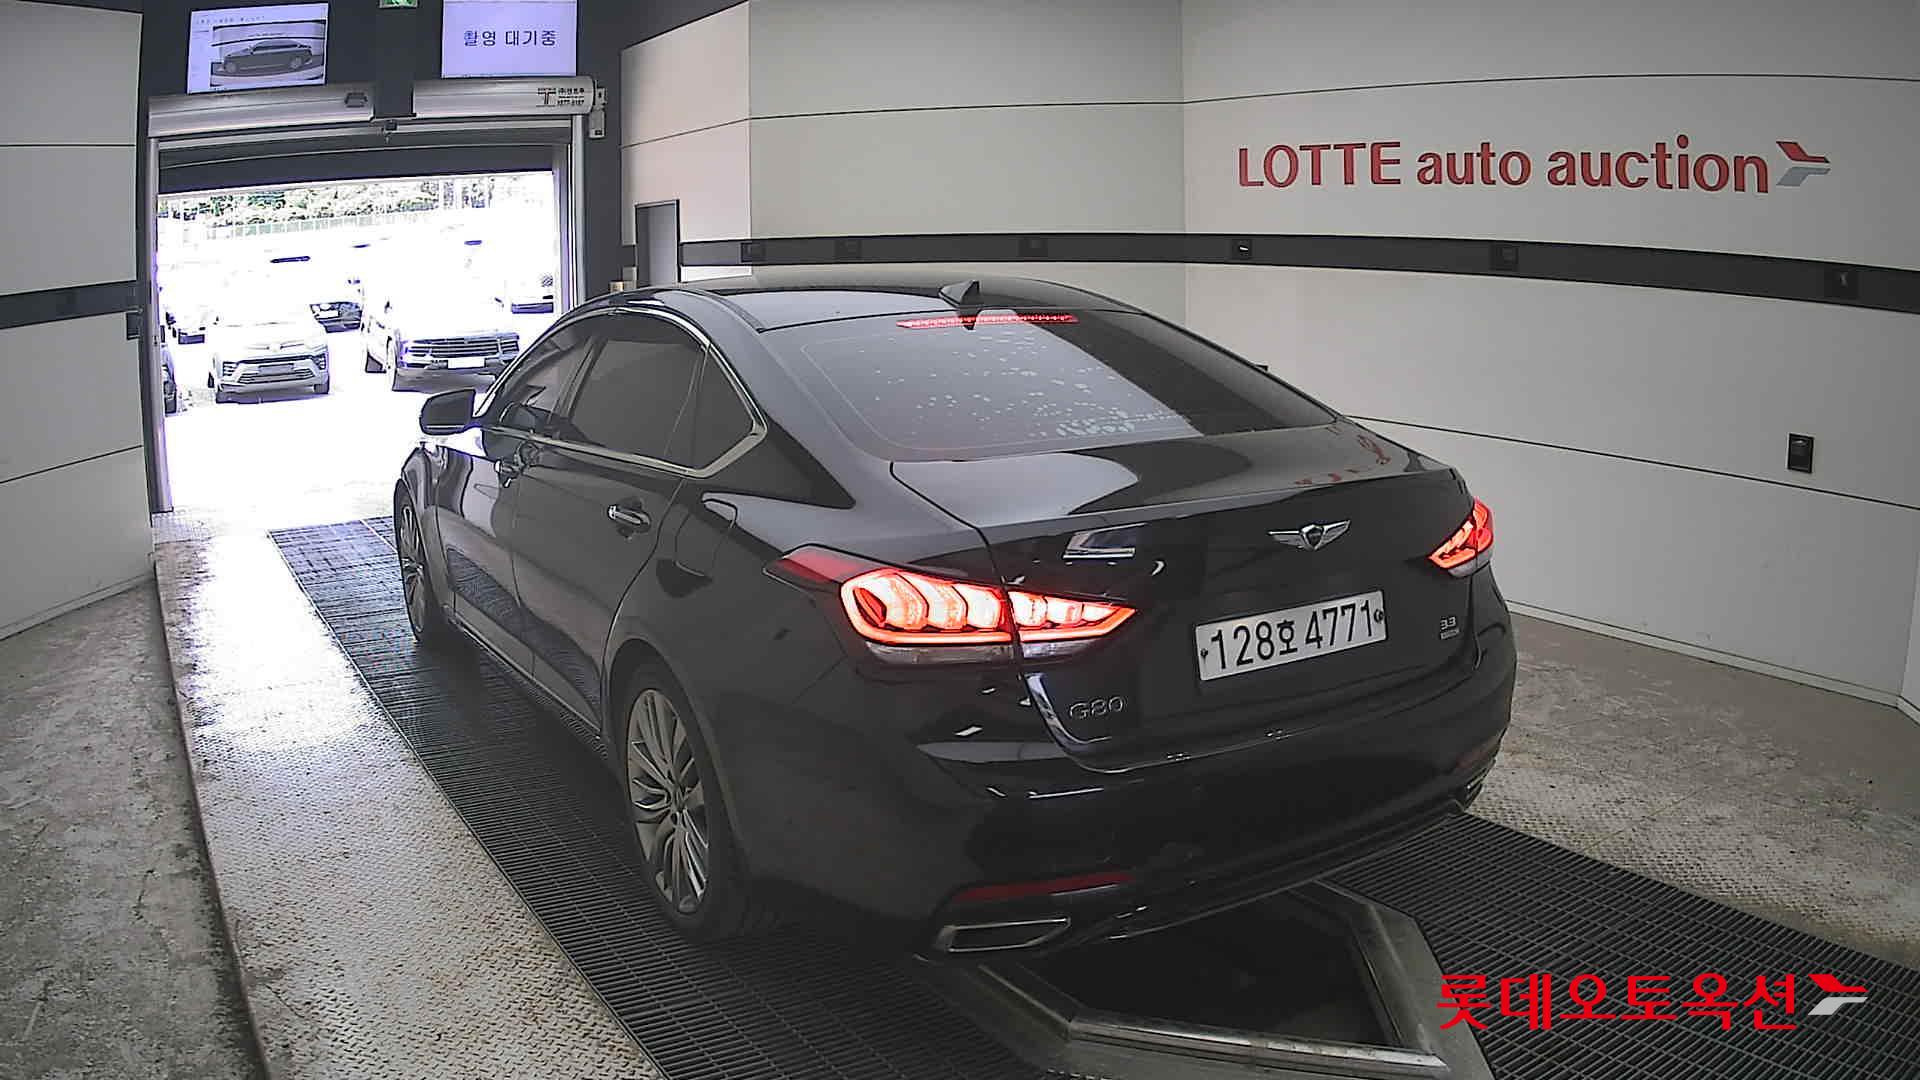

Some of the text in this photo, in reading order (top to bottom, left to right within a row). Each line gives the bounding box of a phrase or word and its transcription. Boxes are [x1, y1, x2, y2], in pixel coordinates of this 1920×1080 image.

[505, 30, 556, 47] 대기중
[1238, 135, 1769, 194] LOTTE auto auction
[1211, 599, 1373, 670] 128호 4771
[1069, 696, 1124, 719] G80
